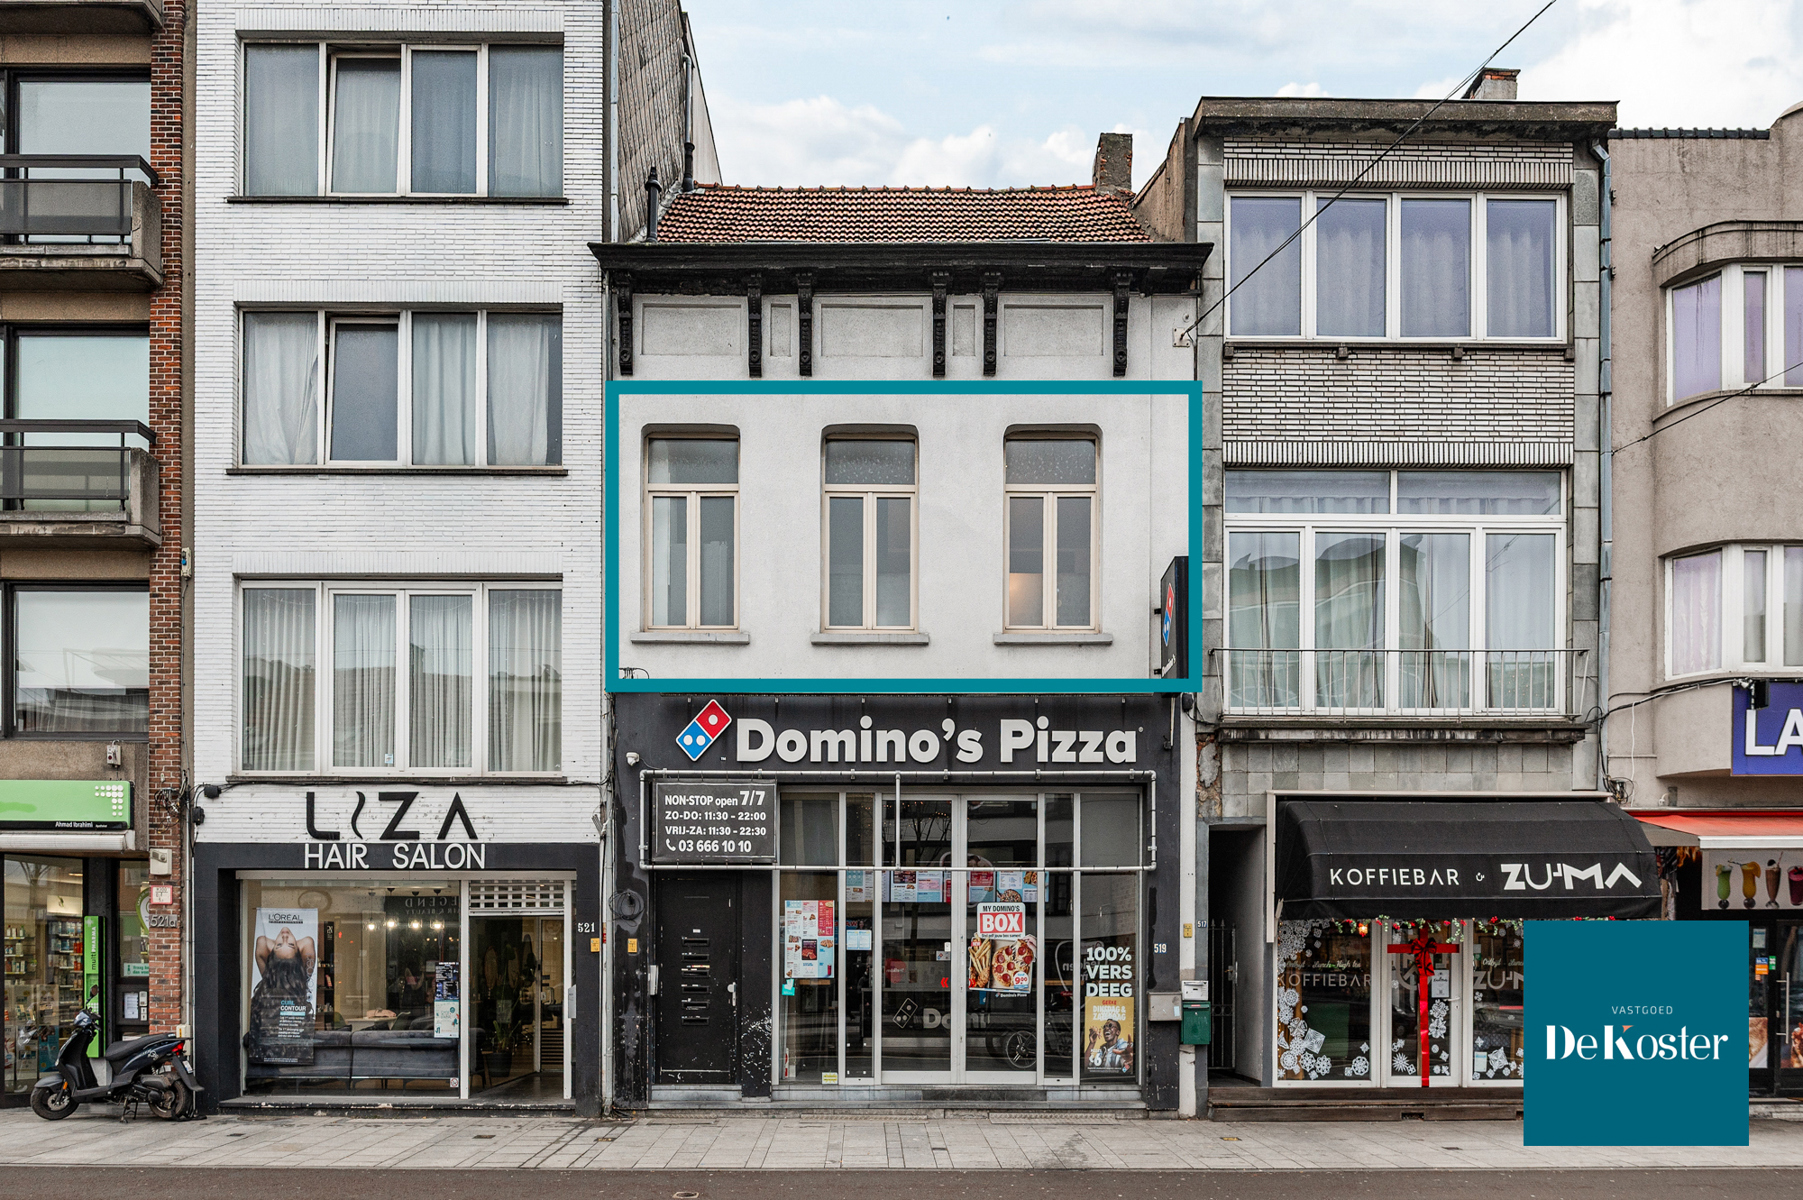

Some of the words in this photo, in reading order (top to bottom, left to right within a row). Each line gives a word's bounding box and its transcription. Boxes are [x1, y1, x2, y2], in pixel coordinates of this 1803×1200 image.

[736, 715, 983, 763] Domino's
[1001, 715, 1137, 763] Pizza
[664, 795, 713, 806] NON-STOP
[715, 797, 738, 808] open
[740, 790, 766, 806] 7/7
[306, 791, 478, 840] LIZA
[664, 811, 702, 820] ZO-DO:
[704, 811, 728, 821] 11:30
[738, 811, 766, 821] 22:00
[664, 826, 706, 836] VRIJ-ZA:
[708, 826, 731, 836] 11:30
[739, 826, 766, 836] 22:30
[678, 840, 694, 852] 03
[696, 840, 719, 852] 666
[721, 840, 736, 853] 10
[738, 840, 752, 853] 10
[304, 843, 370, 869] HAIR
[392, 843, 486, 869] SALON
[1330, 868, 1460, 886] KOFFIEBAR
[150, 915, 176, 927] 521a
[577, 922, 595, 932] 521
[982, 913, 1021, 932] BOX
[1197, 920, 1207, 928] 517
[1086, 946, 1132, 961] 100%
[1154, 943, 1167, 953] 519
[1086, 965, 1133, 979] VERS
[1086, 983, 1133, 997] DEEG
